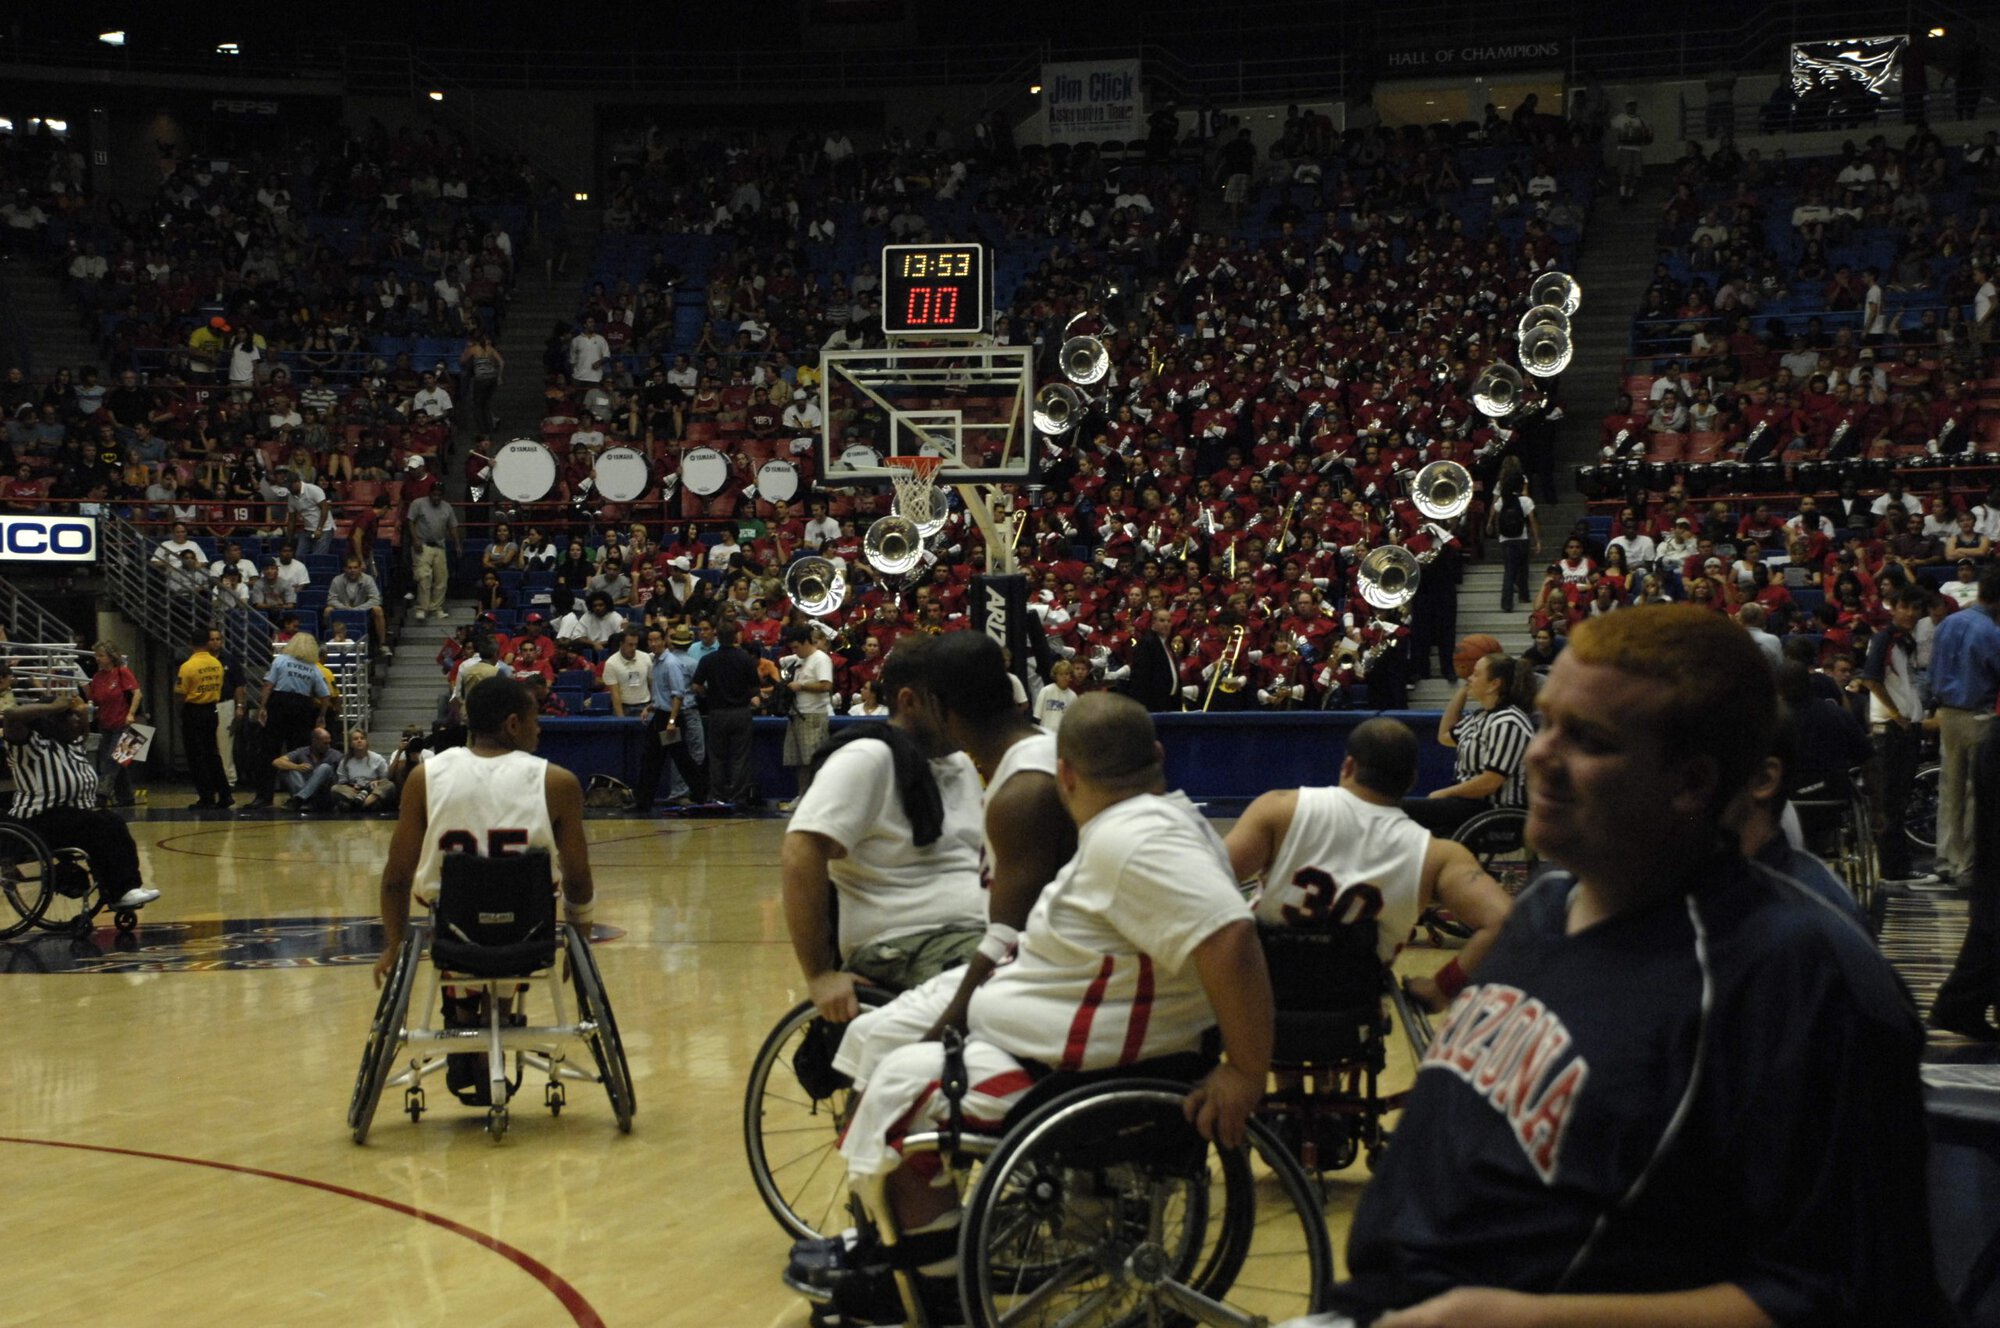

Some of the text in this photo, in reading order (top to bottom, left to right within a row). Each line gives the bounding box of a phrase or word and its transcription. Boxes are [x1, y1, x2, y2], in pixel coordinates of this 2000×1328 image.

[1388, 42, 1560, 65] HALL OF CHAMPIONS
[1049, 71, 1133, 104] Jim Click
[212, 100, 279, 114] PEPSI
[903, 254, 971, 278] 13:53
[906, 286, 959, 324] 00
[695, 453, 716, 461] YAMAHA
[233, 507, 248, 521] 19
[286, 661, 314, 673] EVENT
[287, 670, 312, 681] STAFF
[1283, 866, 1384, 928] 30
